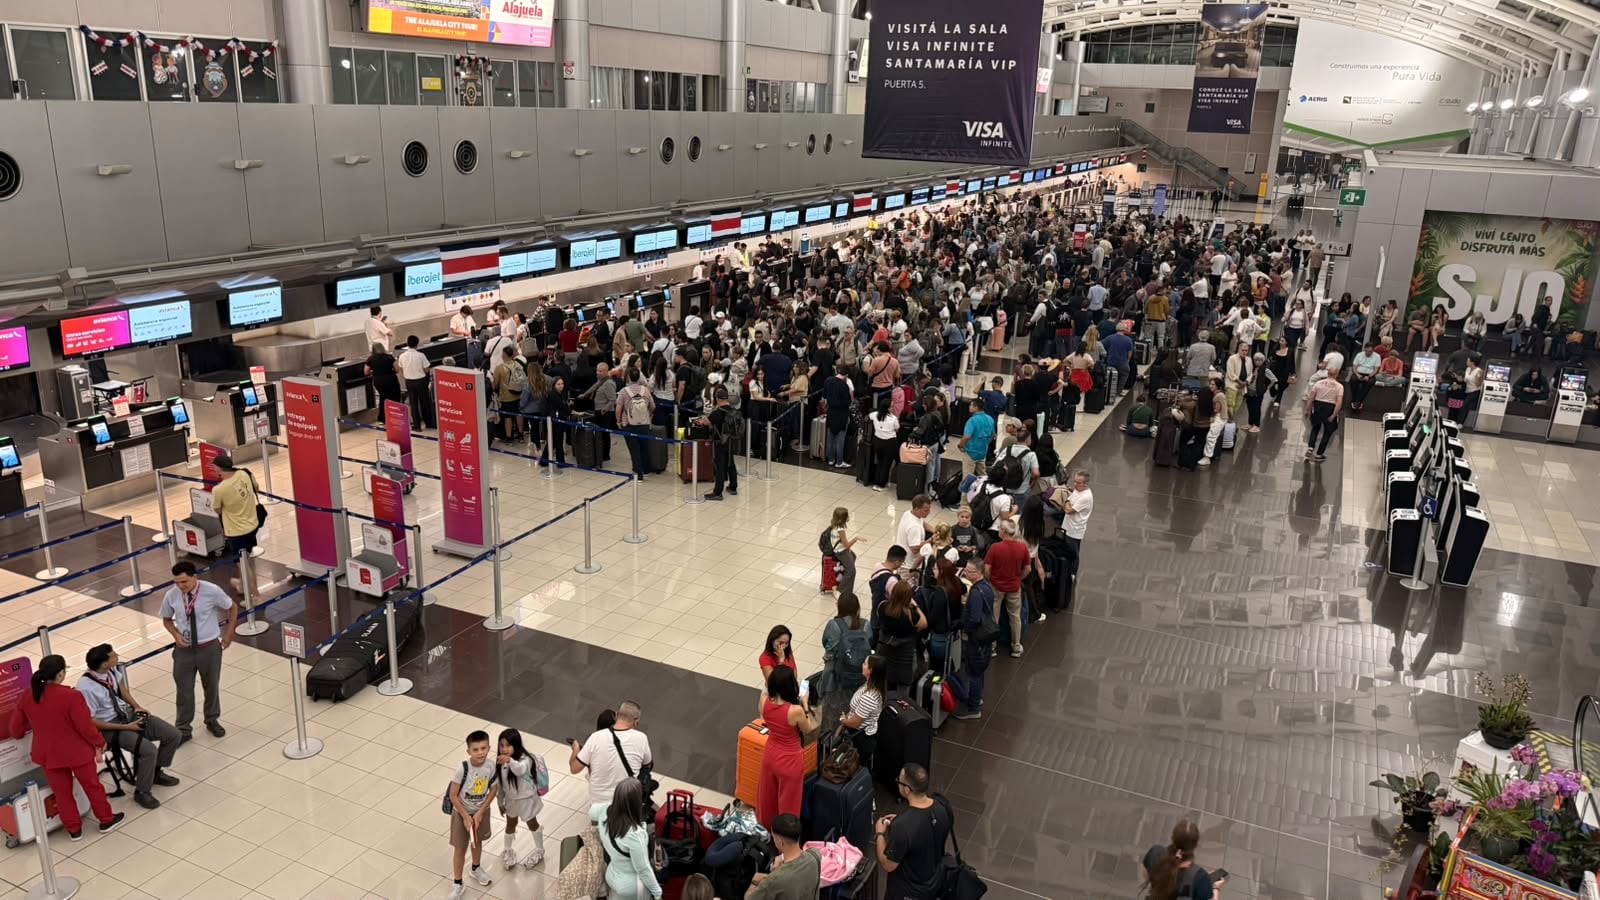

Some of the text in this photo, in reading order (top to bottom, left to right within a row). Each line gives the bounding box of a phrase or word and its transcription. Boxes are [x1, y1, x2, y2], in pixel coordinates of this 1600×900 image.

[502, 2, 543, 17] Alajuela
[888, 22, 1008, 34] VISITÁ LA SALA
[887, 41, 995, 52] VISA INFINITE
[885, 57, 1017, 70] SANTAMARÍA VIP
[1392, 72, 1441, 82] Pura Vida
[884, 80, 926, 89] PUERTA 5.
[962, 120, 1004, 138] VISA
[1500, 232, 1536, 243] LENTO
[1520, 244, 1546, 257] MÁS
[407, 271, 441, 286] iberojet
[93, 316, 117, 324] avianca
[440, 407, 462, 415] servicios
[287, 412, 305, 422] entrega
[294, 422, 317, 431] equipaje
